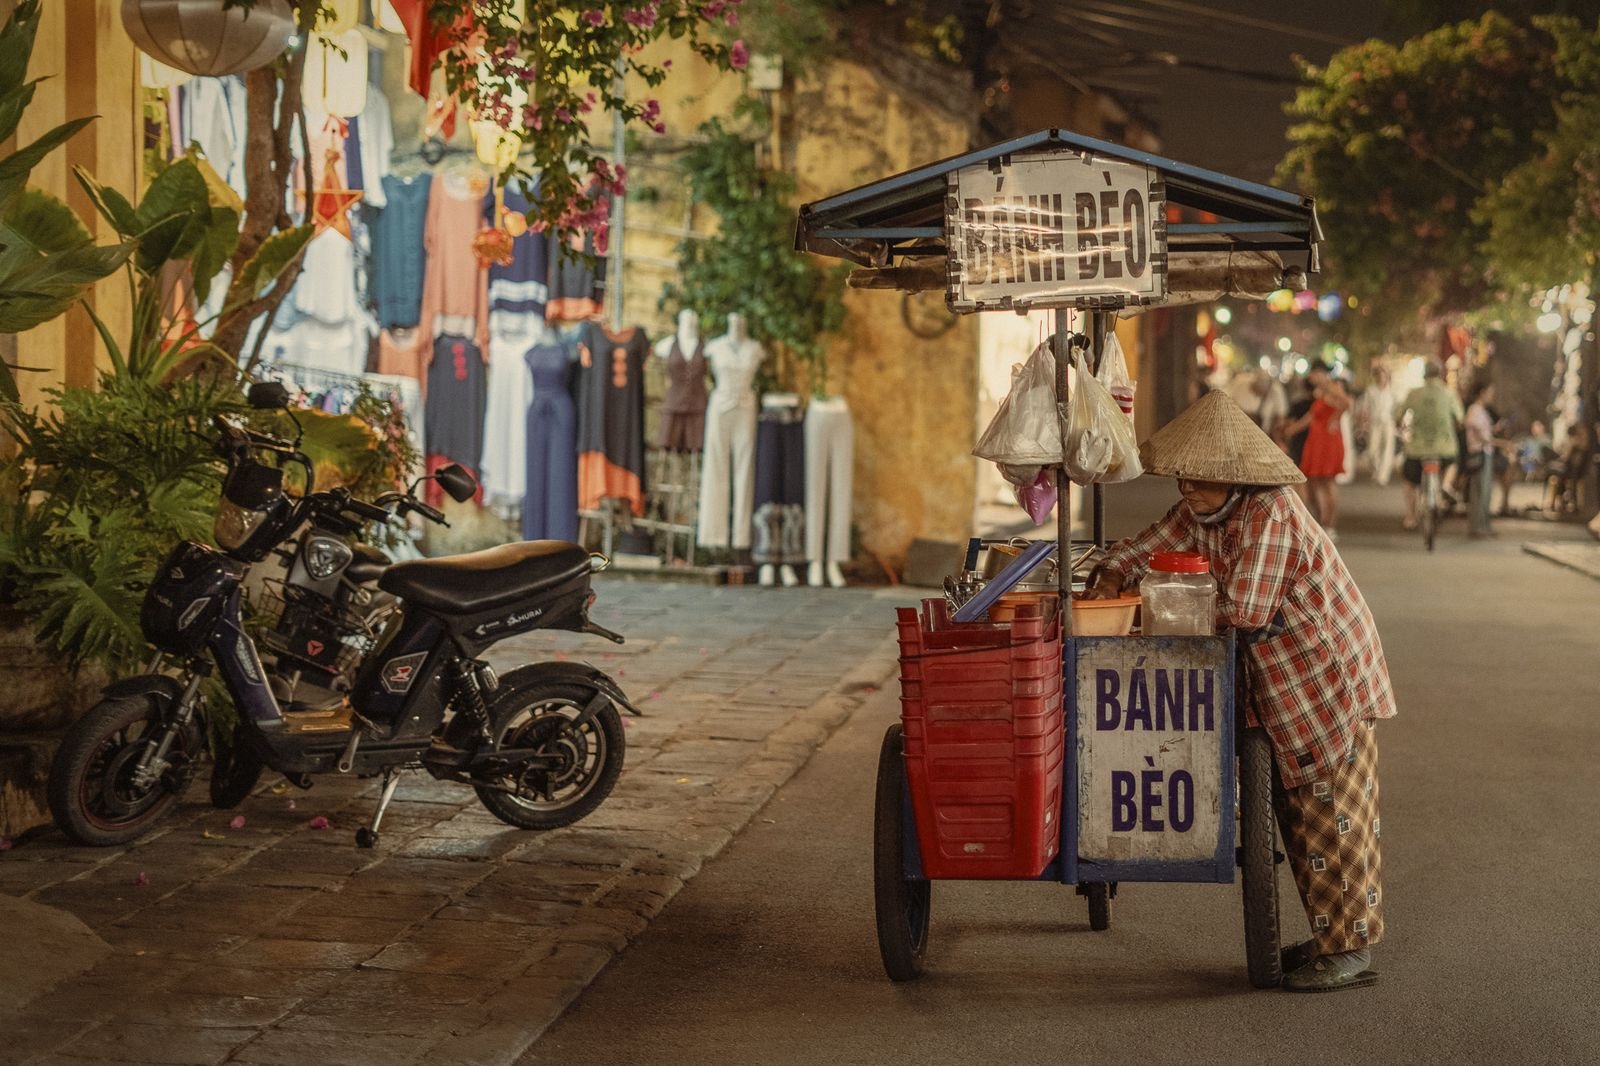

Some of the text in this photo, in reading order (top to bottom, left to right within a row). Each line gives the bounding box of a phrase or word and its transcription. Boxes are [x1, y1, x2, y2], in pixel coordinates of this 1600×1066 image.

[964, 171, 1146, 285] BÁNH BÈO
[506, 608, 543, 626] SAMURAI
[1095, 655, 1215, 732] BÁNH
[1111, 755, 1195, 833] BÈO
